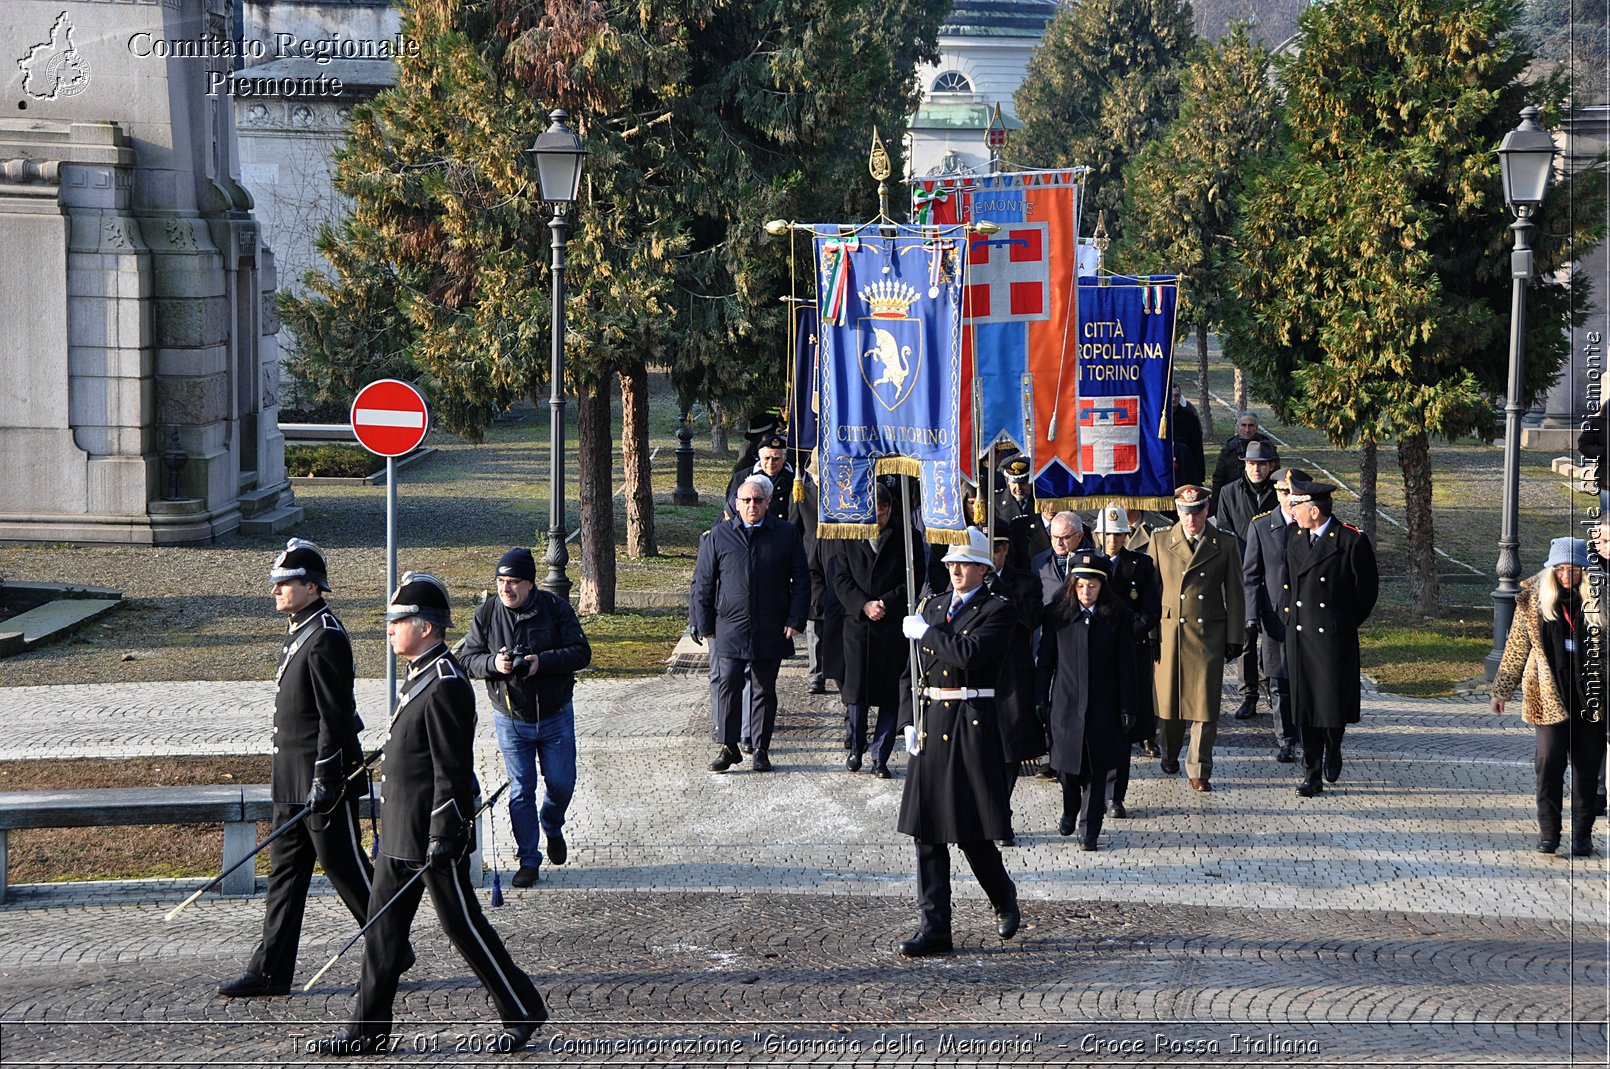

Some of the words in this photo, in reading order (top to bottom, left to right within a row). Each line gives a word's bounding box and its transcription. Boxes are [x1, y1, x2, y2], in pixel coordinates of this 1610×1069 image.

[1084, 318, 1125, 338] CITTÀ
[1086, 364, 1140, 381] TORINO
[883, 425, 898, 441] DI
[899, 426, 948, 446] TORINO
